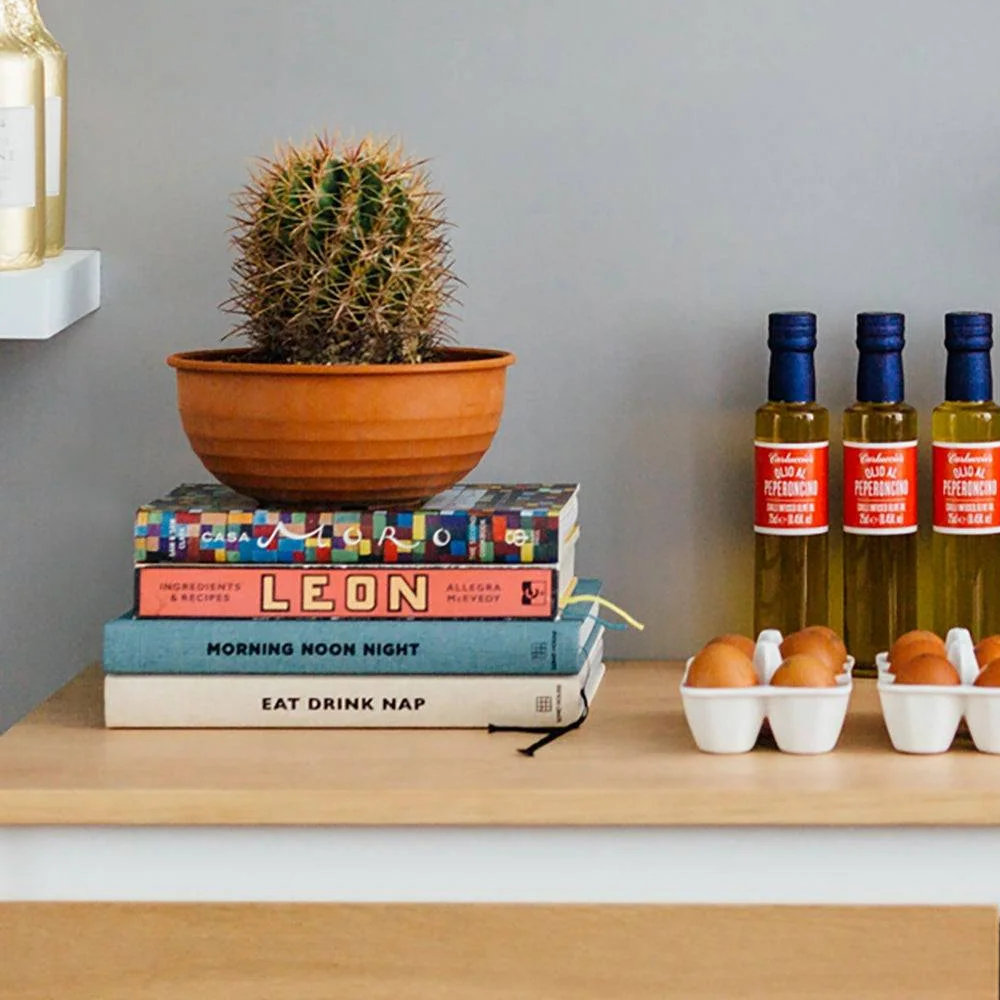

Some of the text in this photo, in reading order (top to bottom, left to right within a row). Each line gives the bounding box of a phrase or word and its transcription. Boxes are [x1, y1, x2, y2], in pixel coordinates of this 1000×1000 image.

[774, 465, 796, 479] OLIO
[864, 465, 887, 479] OLIO
[953, 465, 974, 479] OLIO
[201, 531, 249, 544] CASA
[257, 521, 451, 549] MORO
[159, 583, 242, 592] INGREDIENTS
[260, 573, 429, 613] LEON
[446, 583, 502, 592] ALLEGRA
[170, 594, 231, 602] & RECIPES
[207, 642, 420, 656] MORNING NOON NIGHT
[262, 697, 426, 711] EAT DRINK NAP
